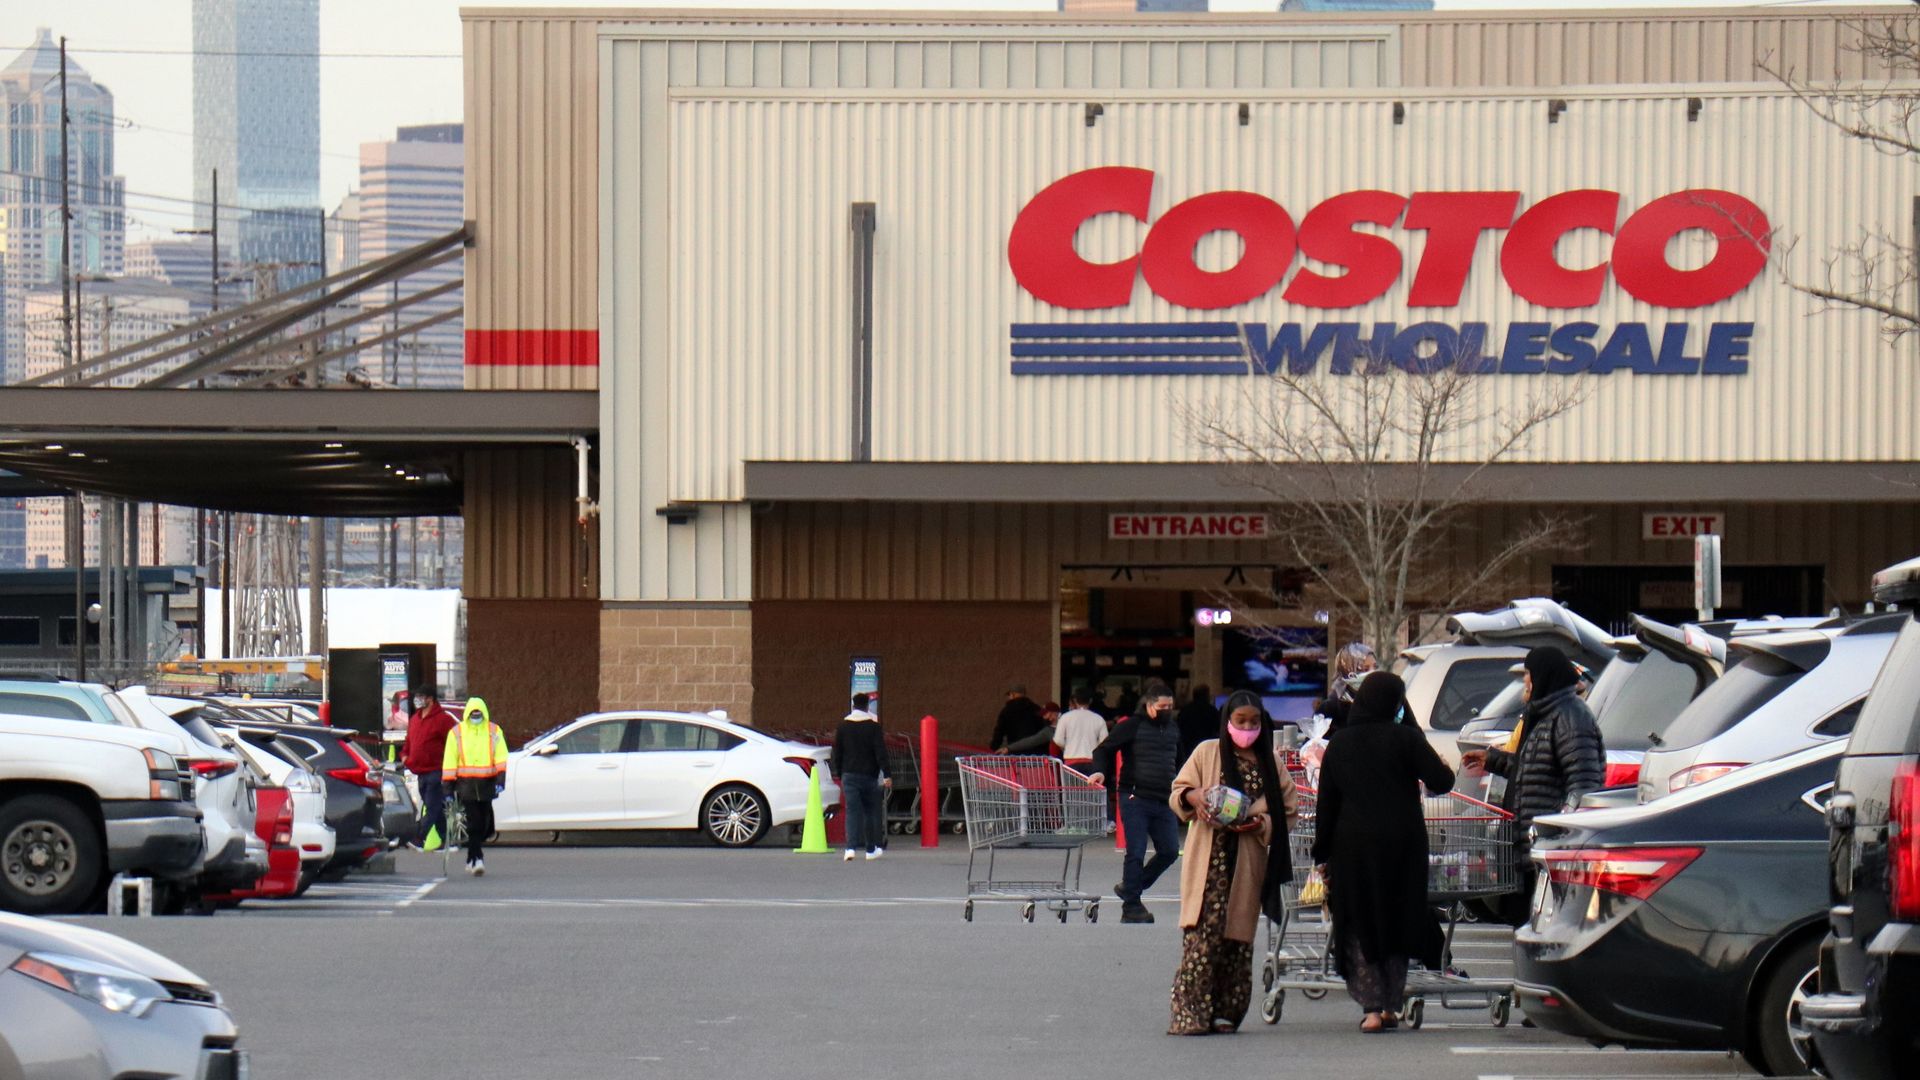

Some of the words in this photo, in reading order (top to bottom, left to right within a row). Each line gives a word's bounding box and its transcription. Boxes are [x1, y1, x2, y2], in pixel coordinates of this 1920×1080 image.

[1007, 166, 1771, 310] COSTCO
[1243, 322, 1755, 376] WHOLESALE
[1113, 516, 1265, 536] ENTRANCE
[1651, 516, 1717, 536] EXIT
[1213, 610, 1232, 624] LG
